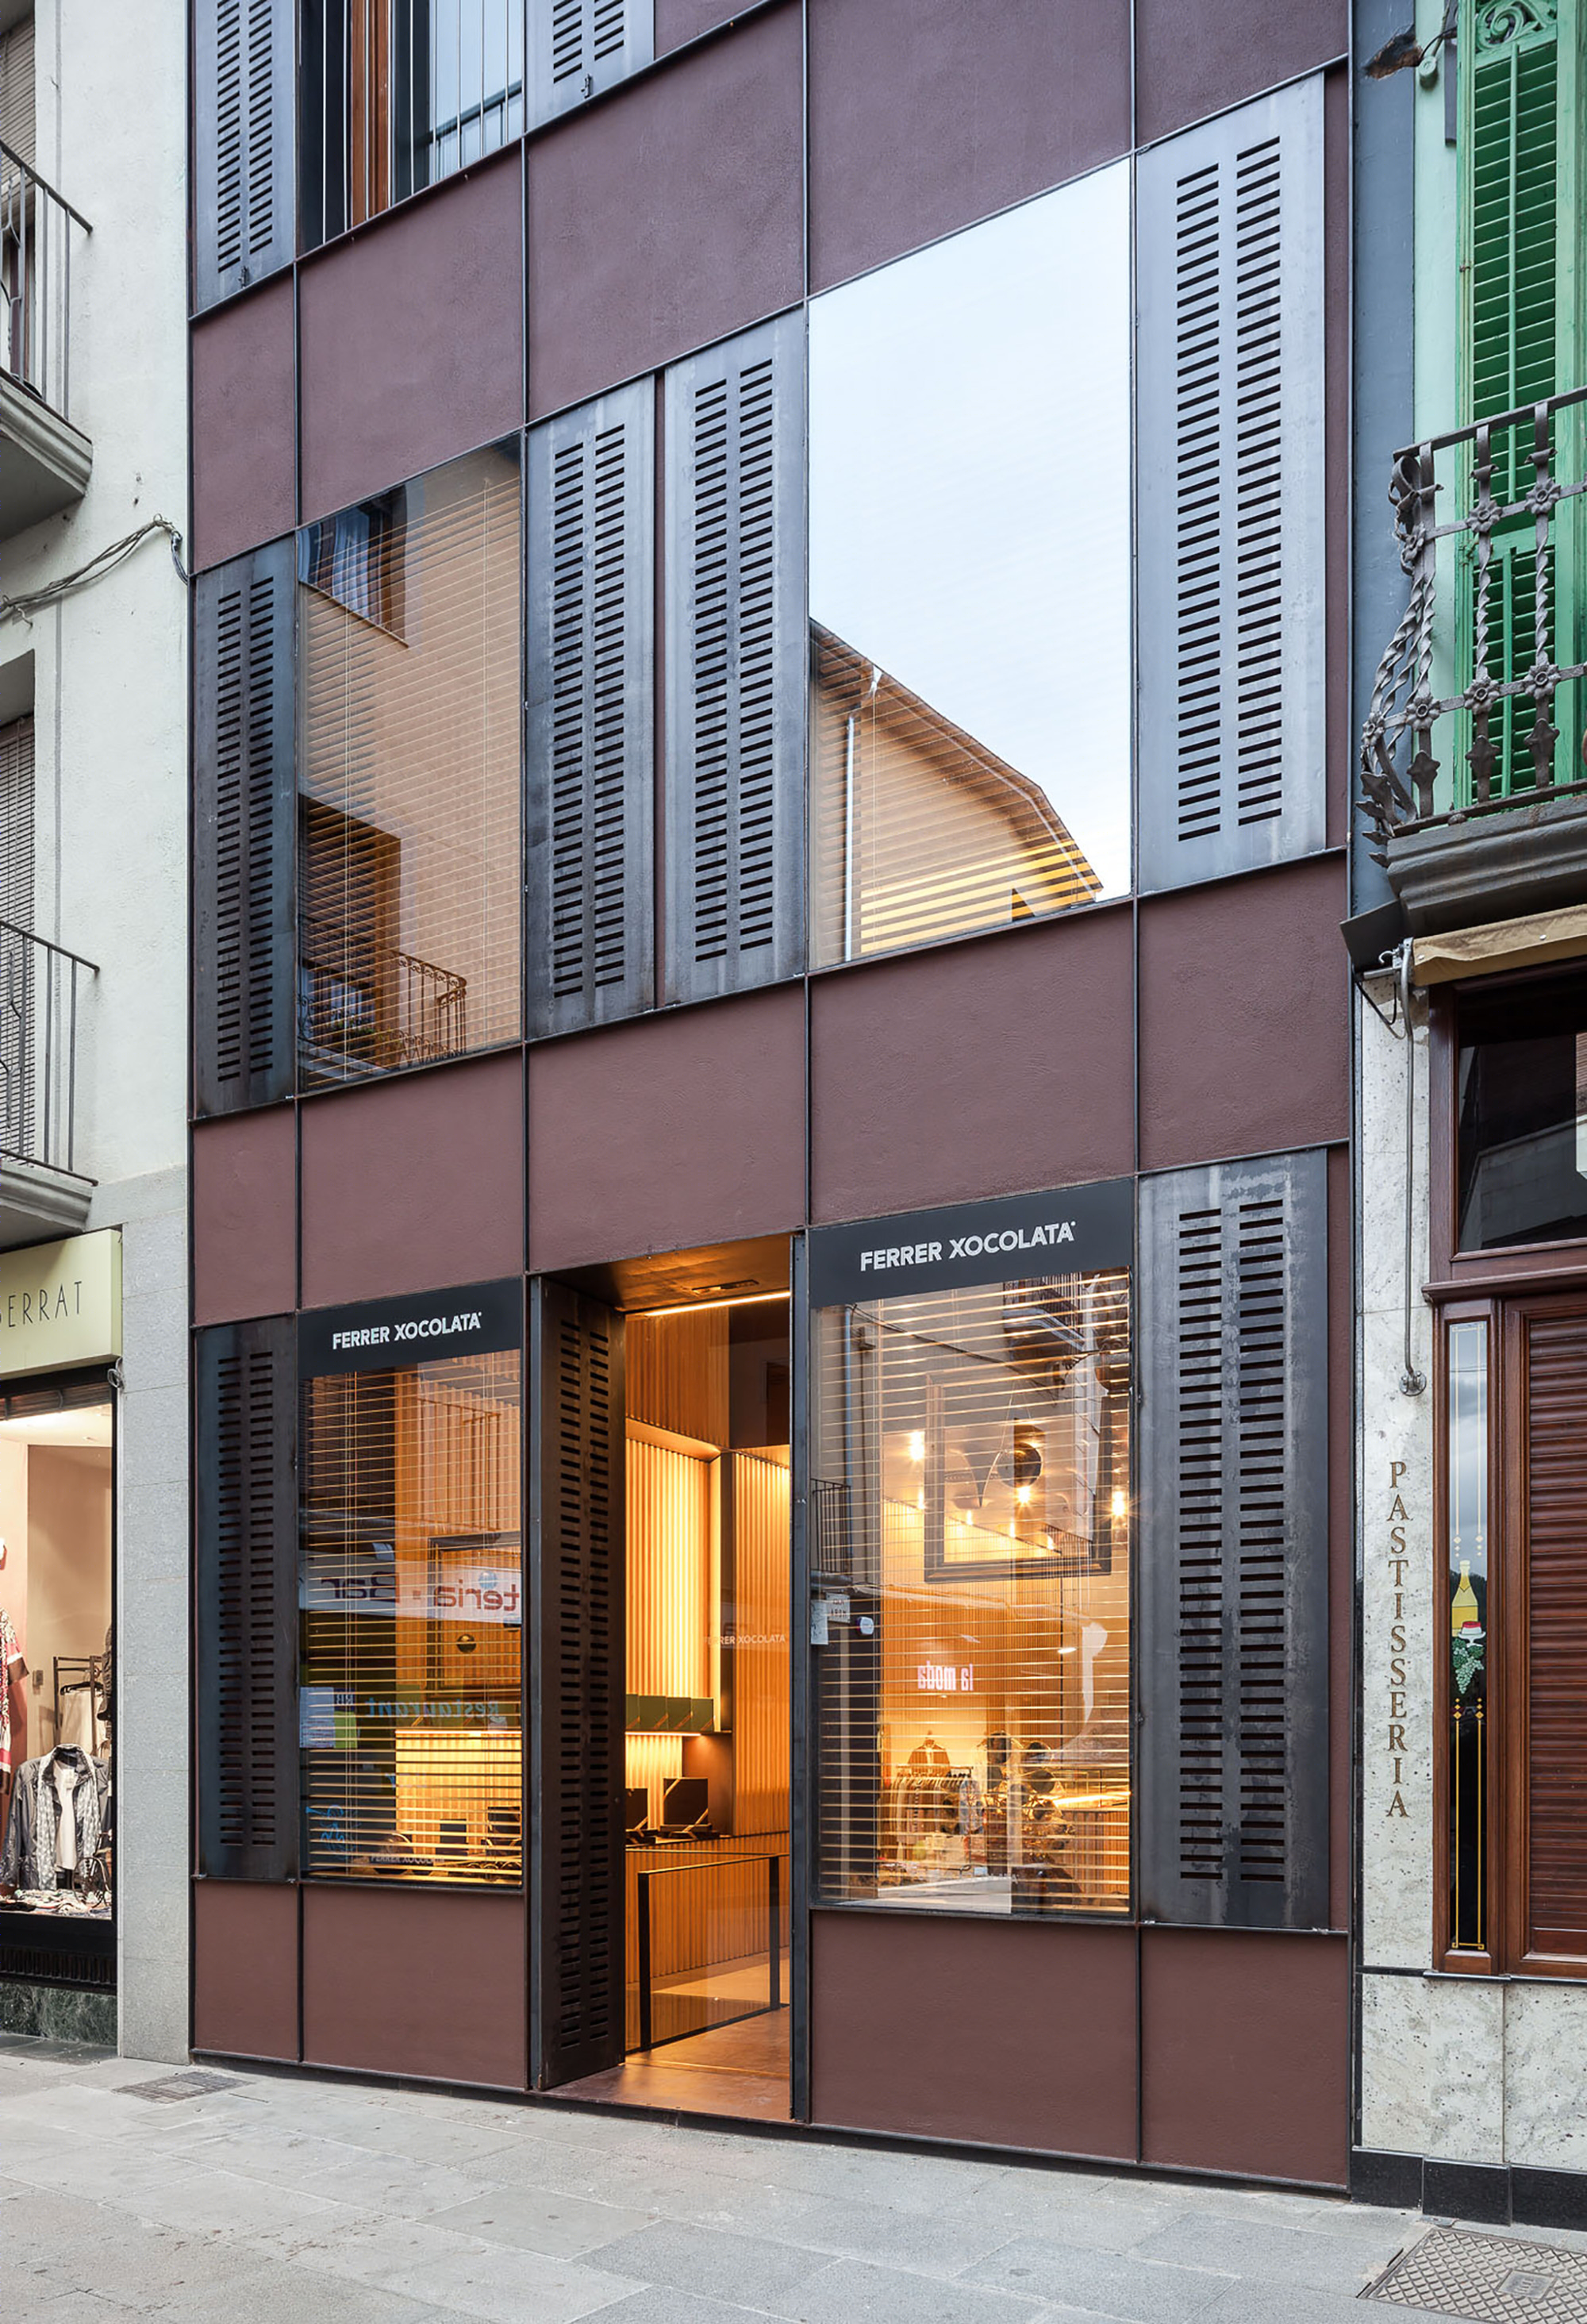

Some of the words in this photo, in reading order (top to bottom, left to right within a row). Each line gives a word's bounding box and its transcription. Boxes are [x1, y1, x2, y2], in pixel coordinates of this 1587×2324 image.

[860, 1241, 943, 1272] FERRER
[0, 1280, 83, 1328] ERRAT
[332, 1326, 390, 1349] FERRER
[738, 1633, 786, 1645] XOCOLATA
[1385, 1460, 1411, 1818] PASTISSERIA
